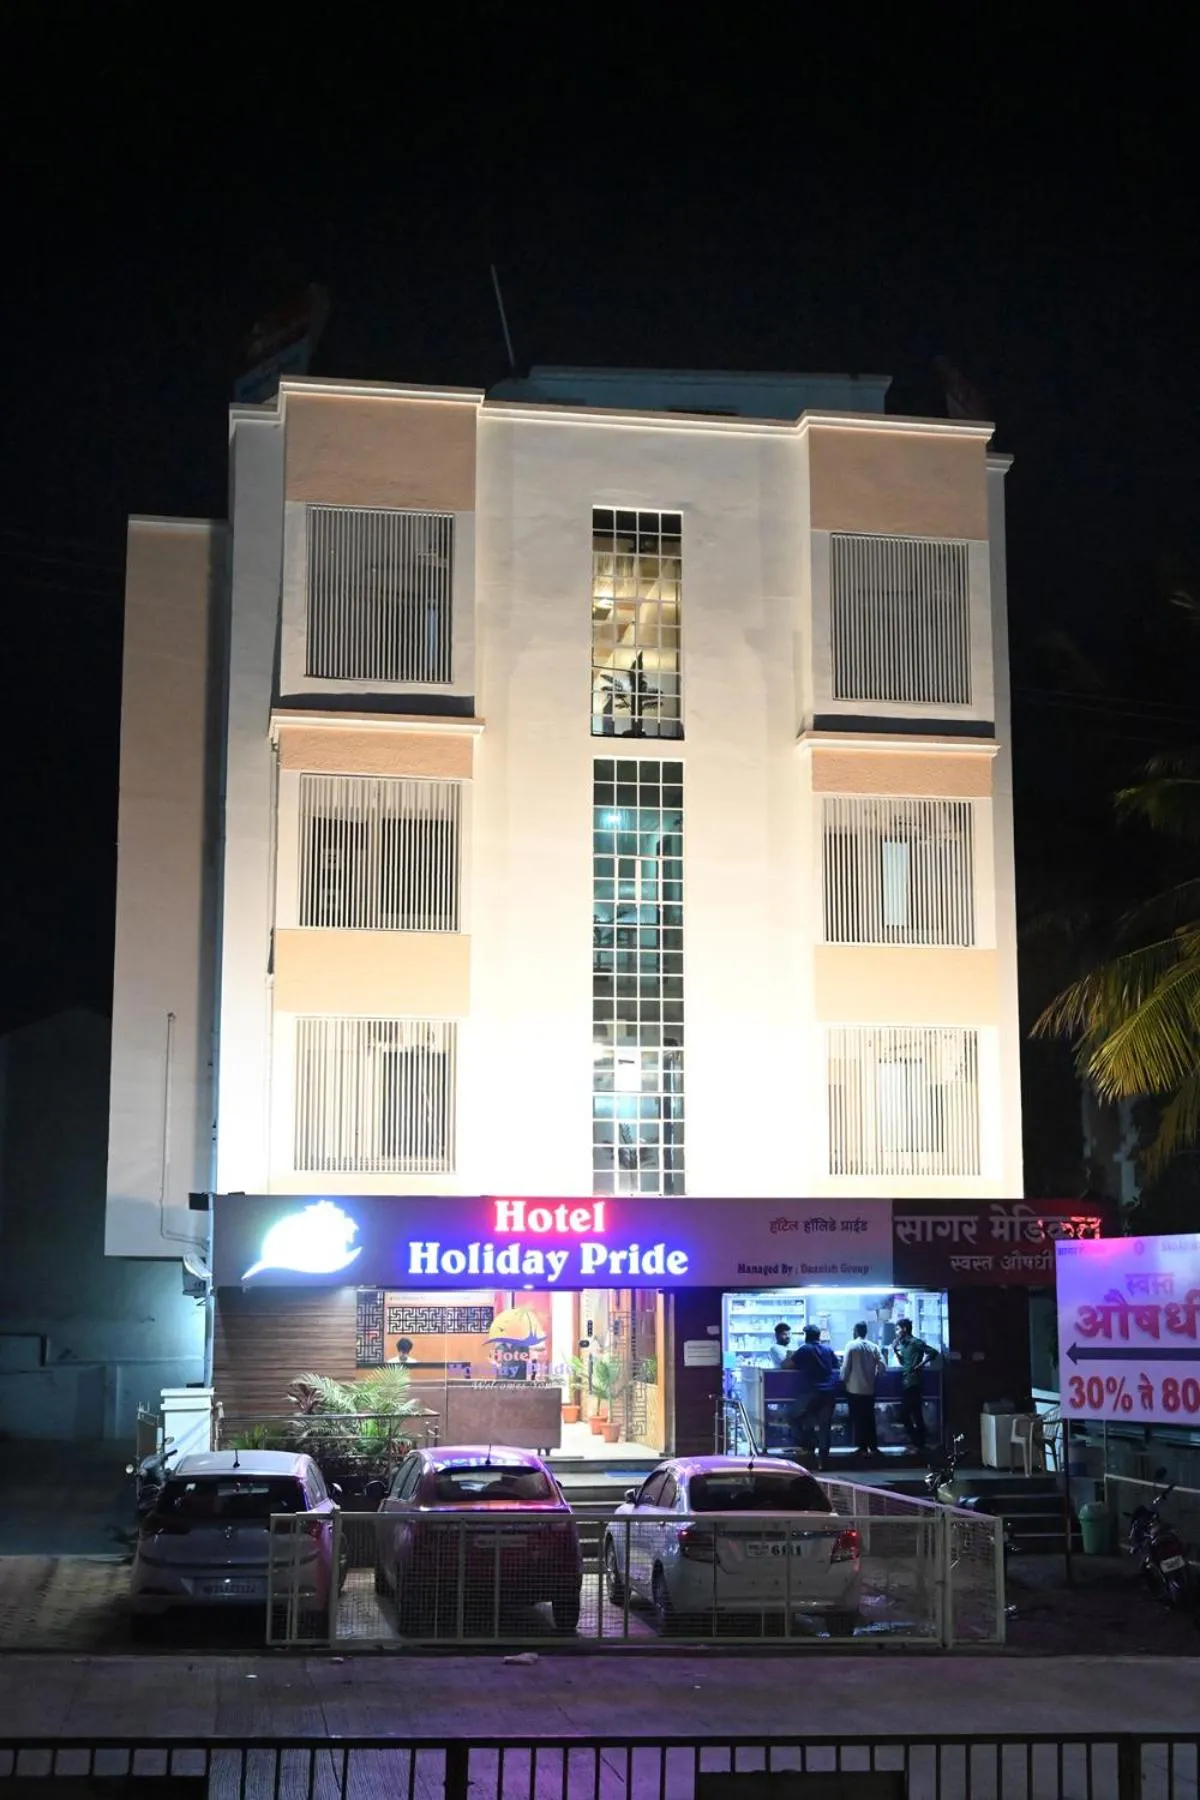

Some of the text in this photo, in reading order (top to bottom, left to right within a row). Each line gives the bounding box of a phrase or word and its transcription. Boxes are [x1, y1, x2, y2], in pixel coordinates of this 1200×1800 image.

[494, 1200, 606, 1234] Hotel
[894, 1204, 1102, 1244] सागर मेडिकल
[408, 1241, 689, 1282] Holiday Pride
[737, 1263, 779, 1277] Managed
[841, 1263, 870, 1276] Group
[950, 1255, 994, 1272] स्वस्त
[1126, 1273, 1175, 1297] स्वस्त
[1069, 1375, 1133, 1413] 30%
[1138, 1372, 1154, 1411] ते
